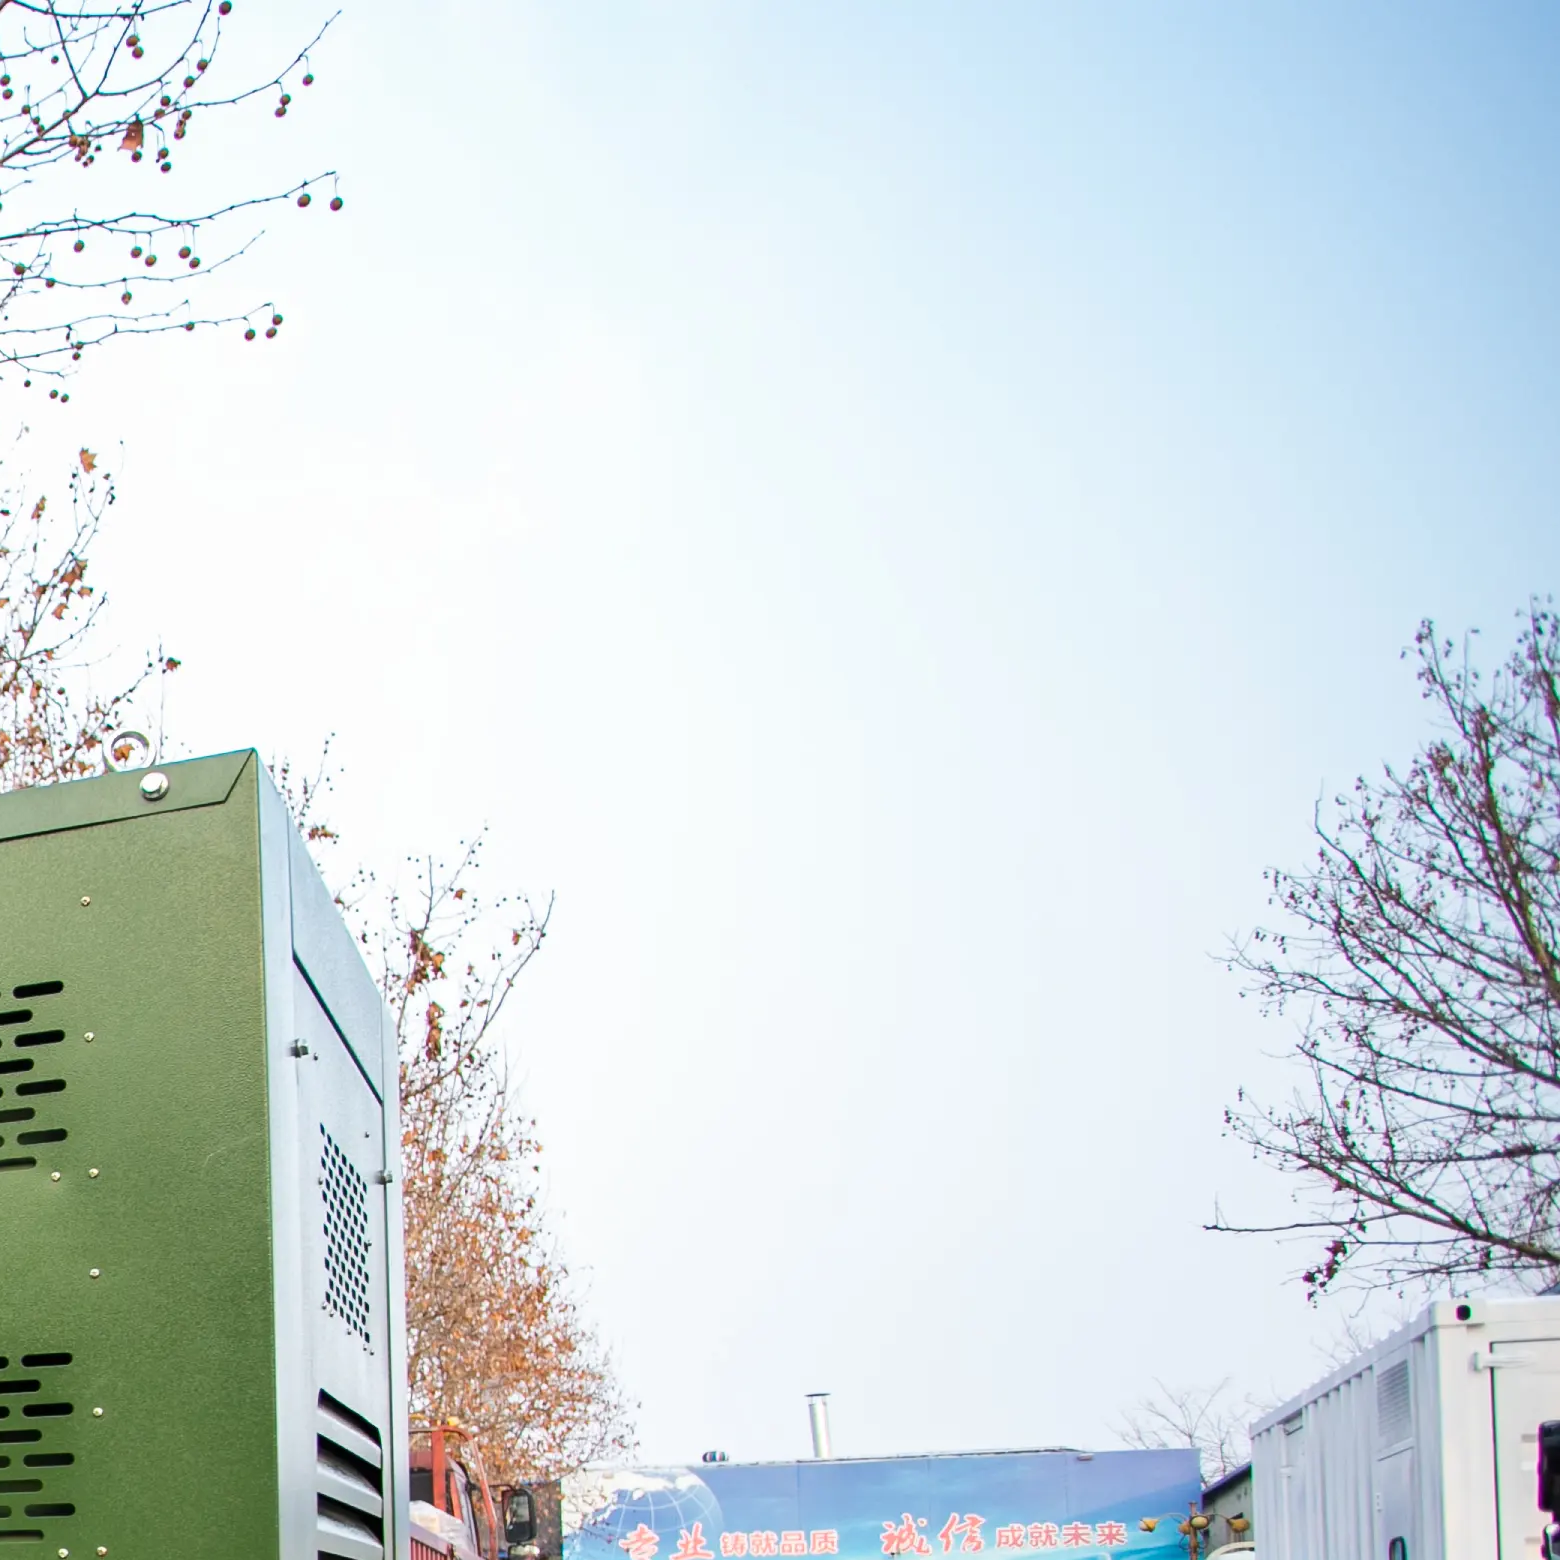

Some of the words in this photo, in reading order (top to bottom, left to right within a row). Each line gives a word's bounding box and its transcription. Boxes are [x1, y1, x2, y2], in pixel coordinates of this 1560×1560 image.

[880, 1511, 1129, 1557] 诚信成就未来
